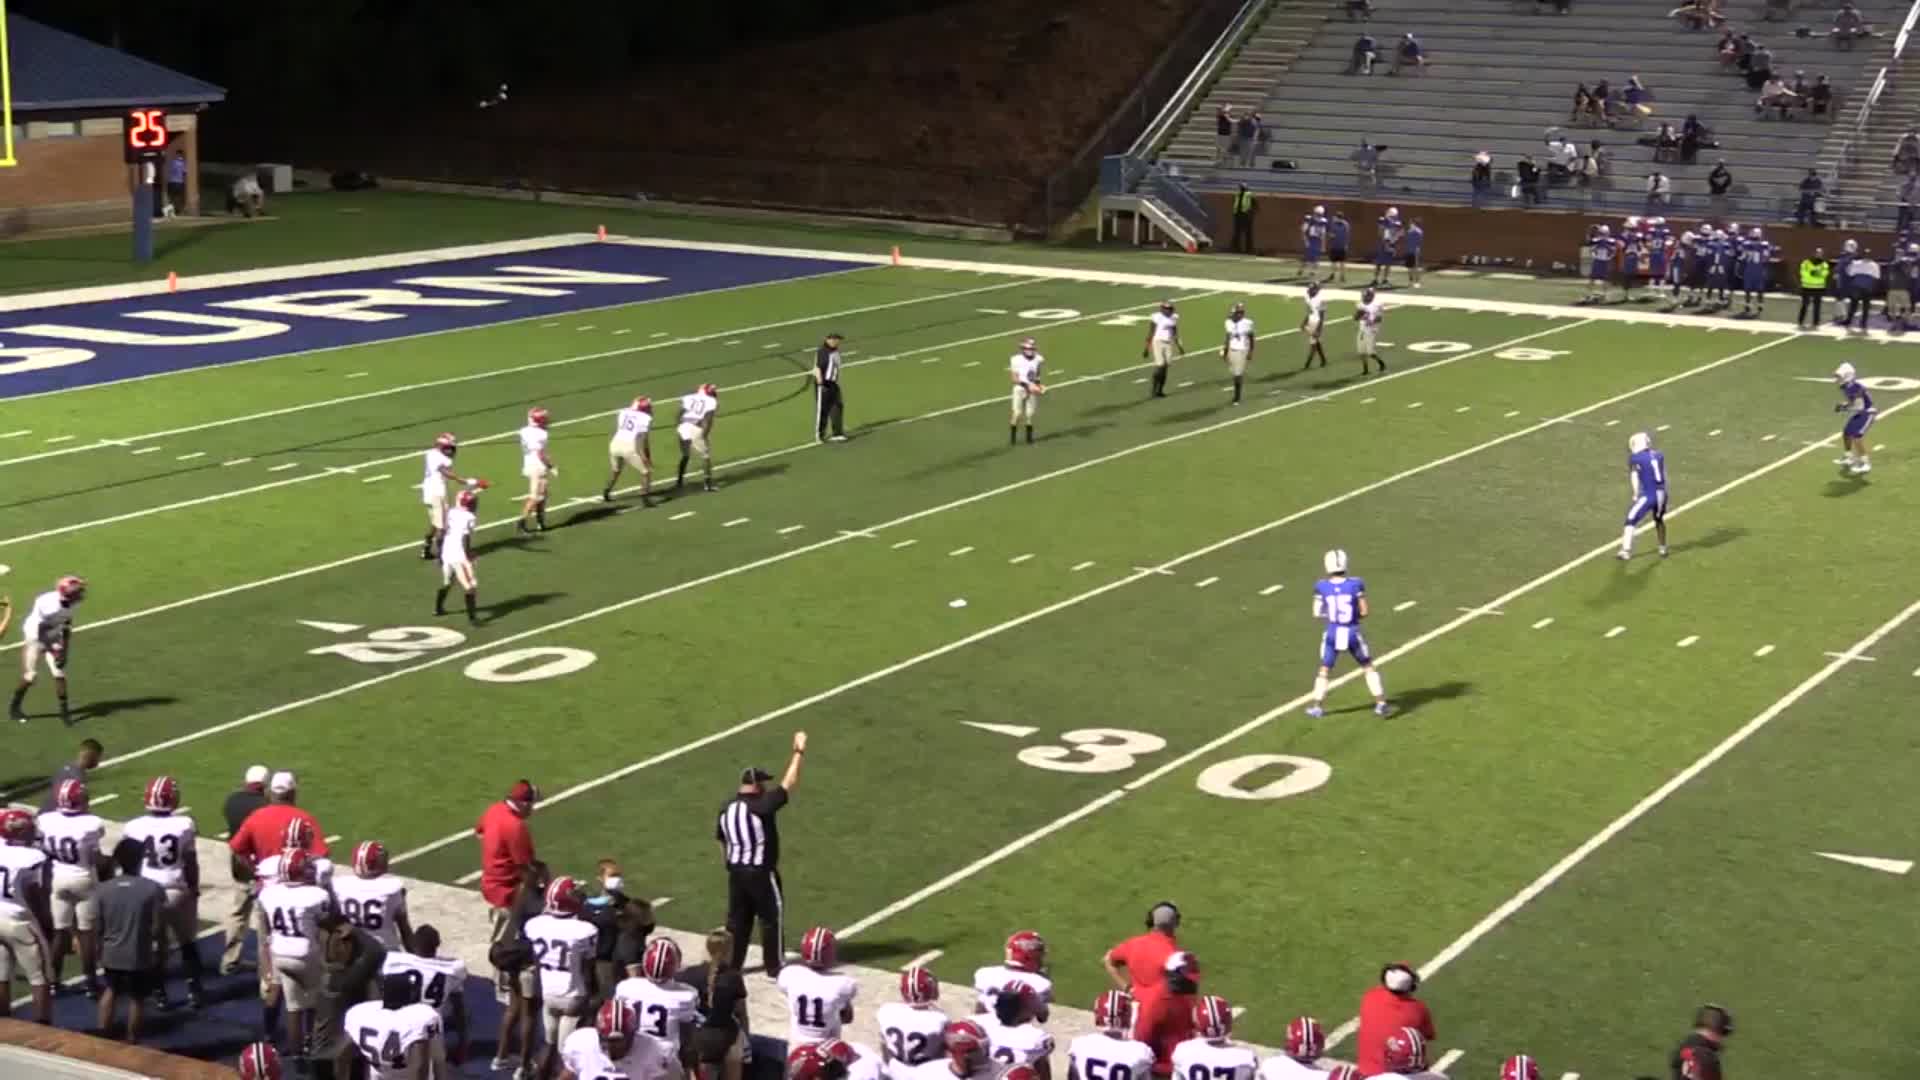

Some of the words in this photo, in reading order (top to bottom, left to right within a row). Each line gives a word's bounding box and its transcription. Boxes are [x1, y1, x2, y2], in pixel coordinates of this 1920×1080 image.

[131, 110, 165, 147] 25
[1650, 458, 1662, 482] 1
[1325, 594, 1353, 623] 15
[272, 906, 306, 937] 41
[633, 1000, 669, 1037] 13
[797, 994, 827, 1028] 11
[359, 1026, 406, 1069] 54
[885, 1027, 928, 1066] 32
